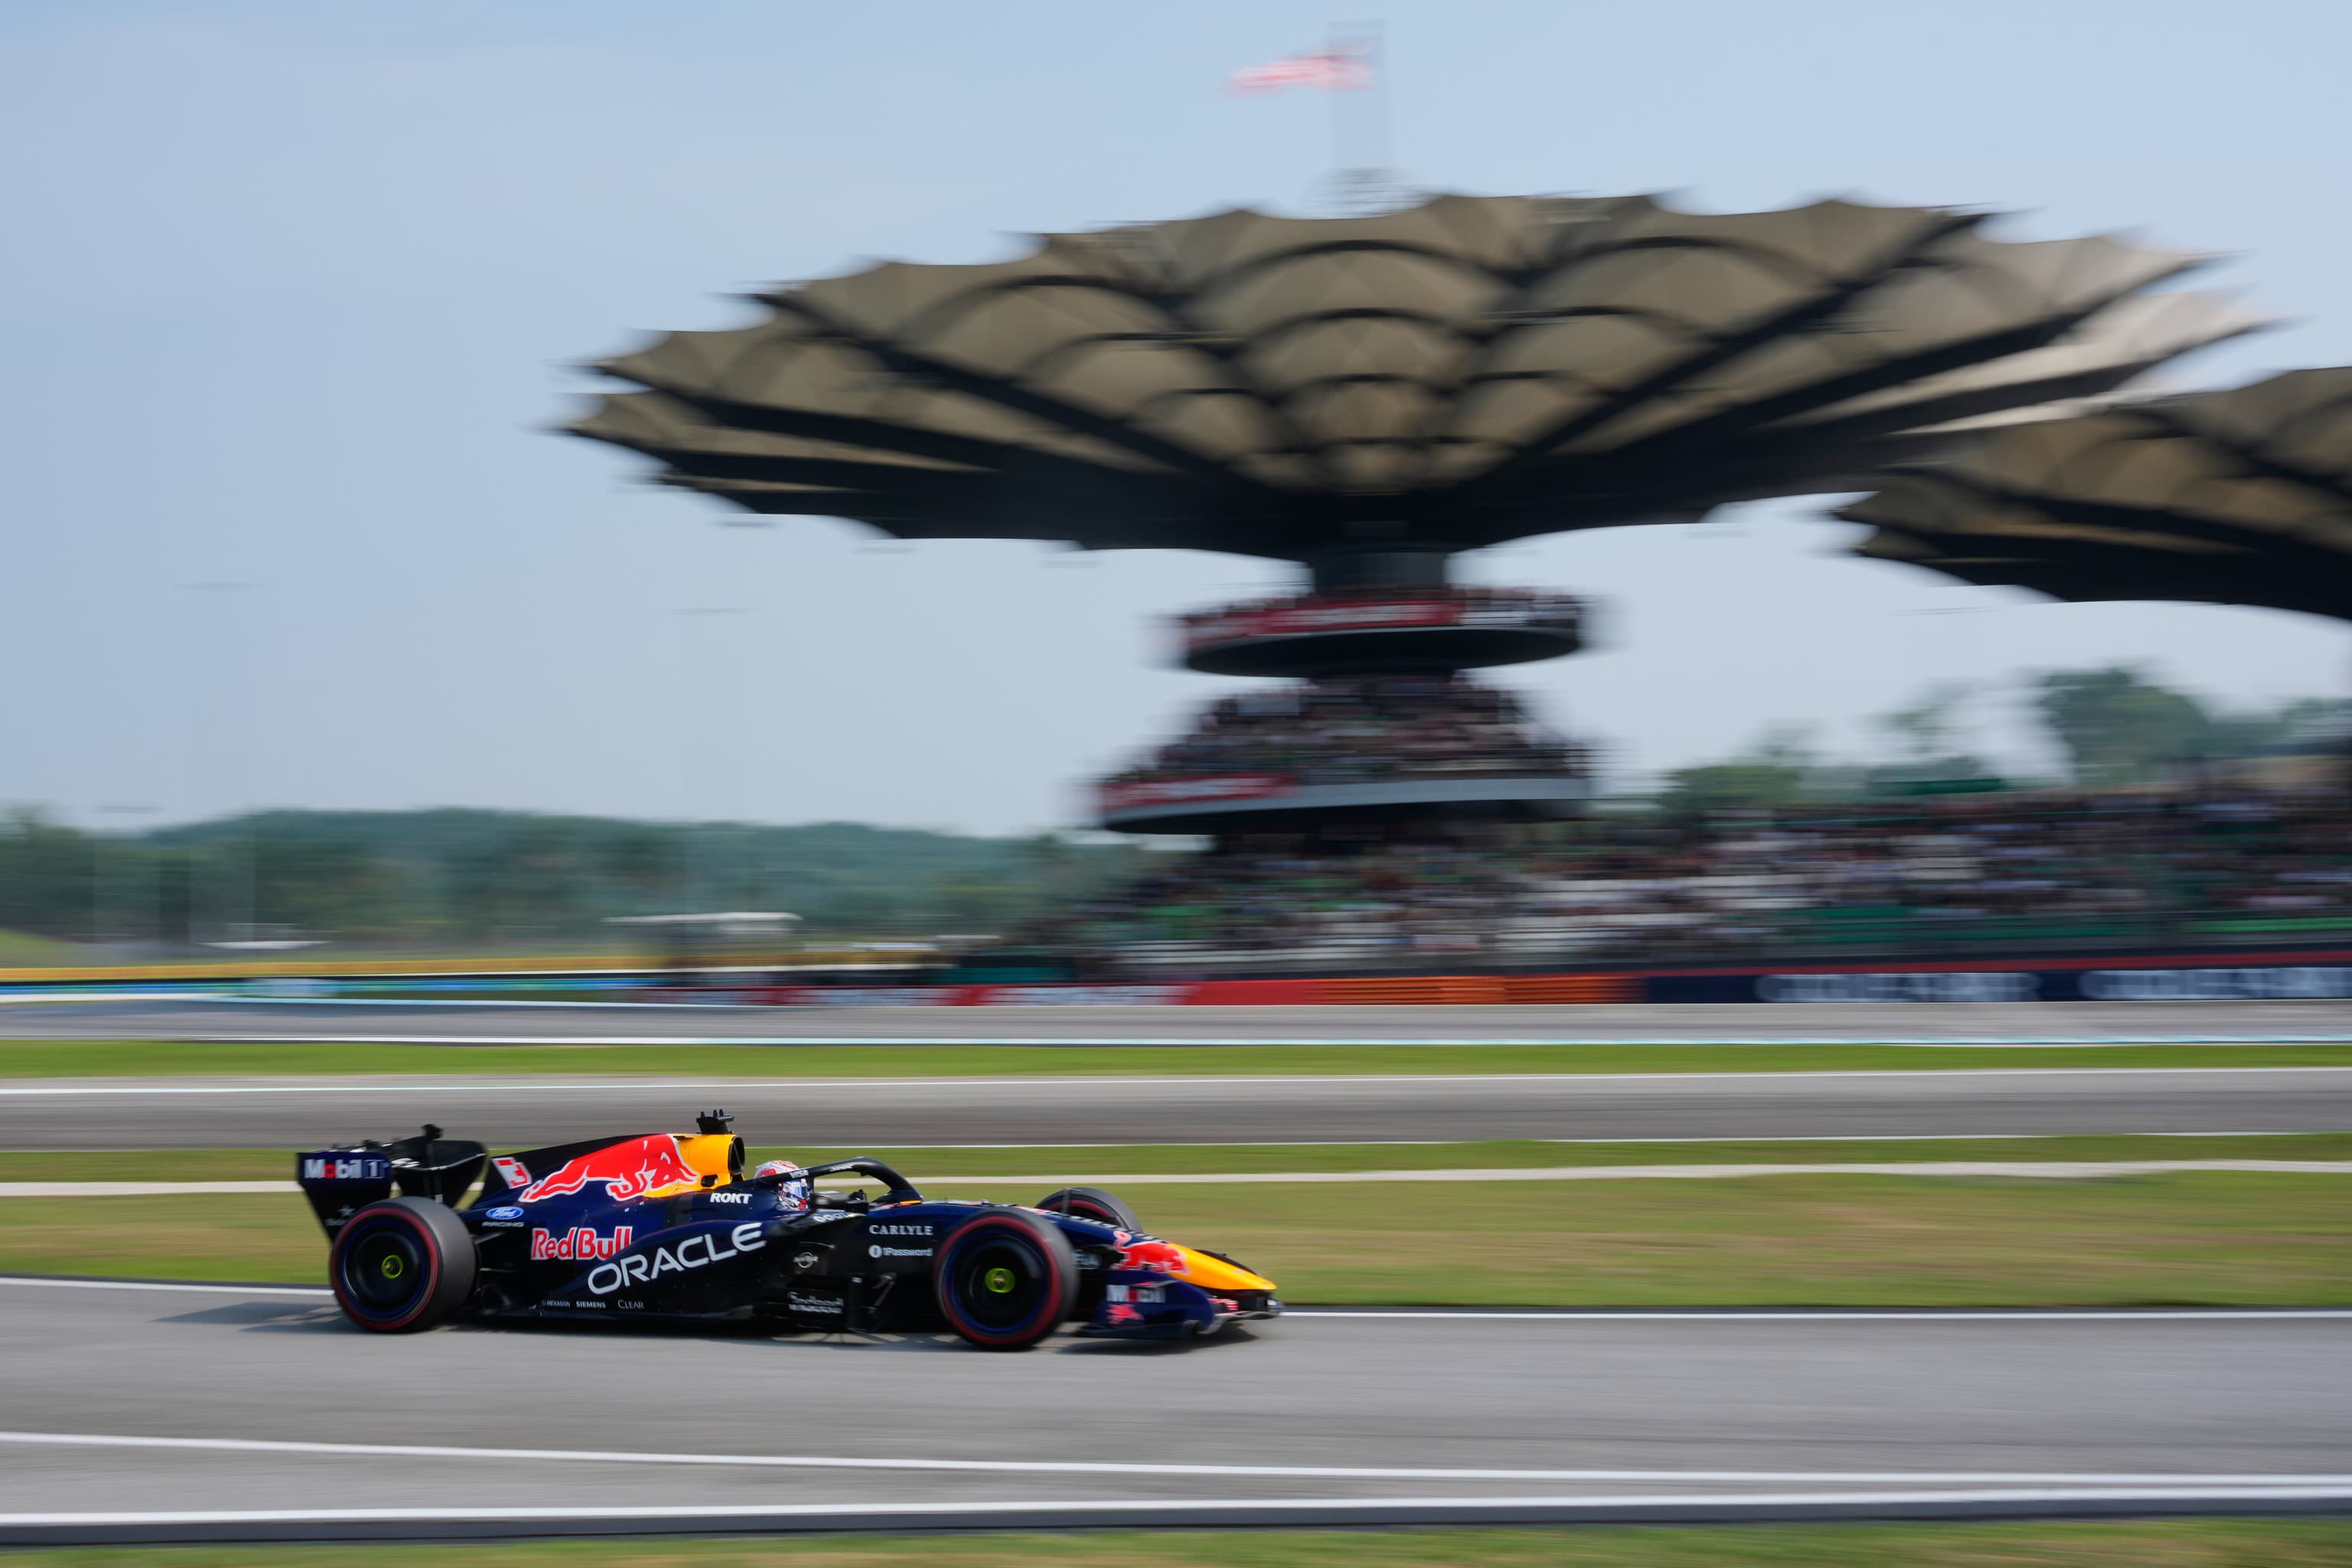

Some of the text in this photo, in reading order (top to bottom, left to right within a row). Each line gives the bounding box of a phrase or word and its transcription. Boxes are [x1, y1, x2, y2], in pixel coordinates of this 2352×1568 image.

[304, 1158, 363, 1179] Mobil
[710, 1192, 753, 1204] ROKT
[868, 1224, 933, 1236] CARLYLE
[531, 1226, 633, 1261] Red Bull
[587, 1222, 767, 1295] ORACLE
